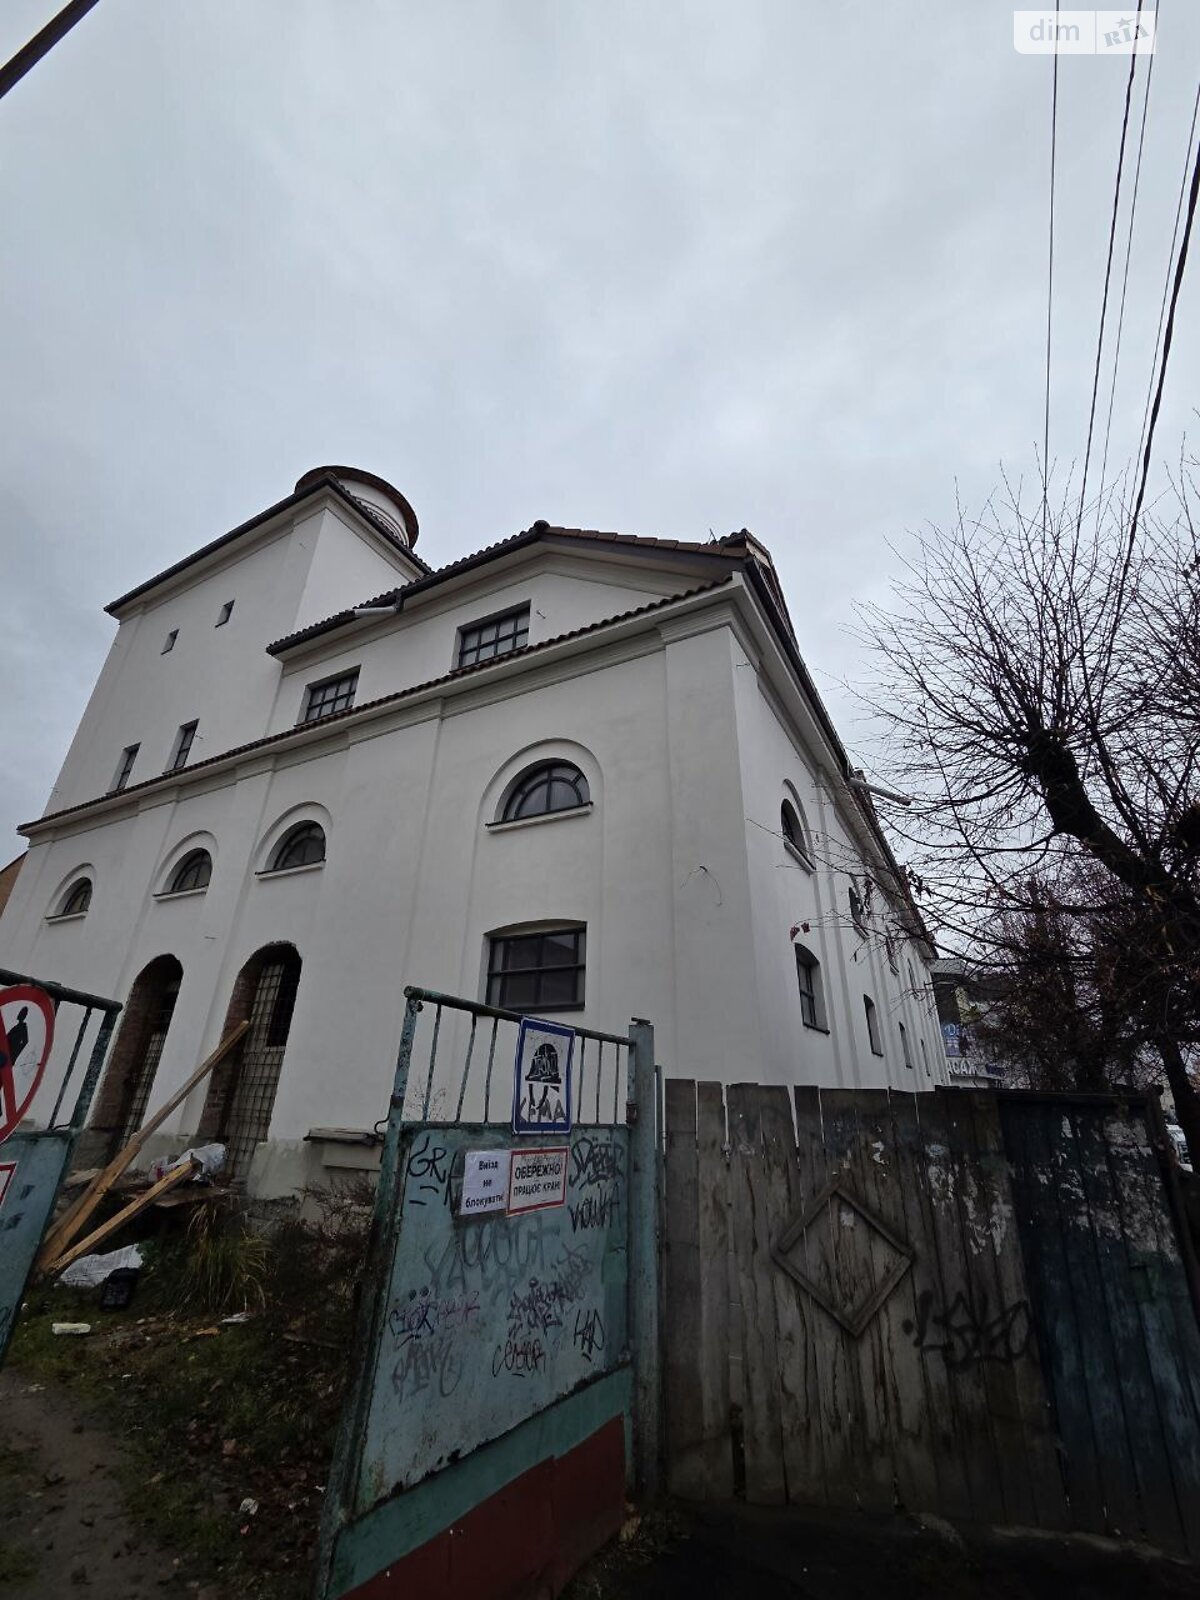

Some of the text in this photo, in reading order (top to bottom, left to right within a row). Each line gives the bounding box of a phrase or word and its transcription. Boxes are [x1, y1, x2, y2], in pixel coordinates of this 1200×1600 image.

[478, 1160, 499, 1171] Виїзд
[514, 1162, 562, 1180] ОБЕРЕЖНО!
[482, 1179, 492, 1188] не
[513, 1183, 541, 1197] ПРАЦЮЄ
